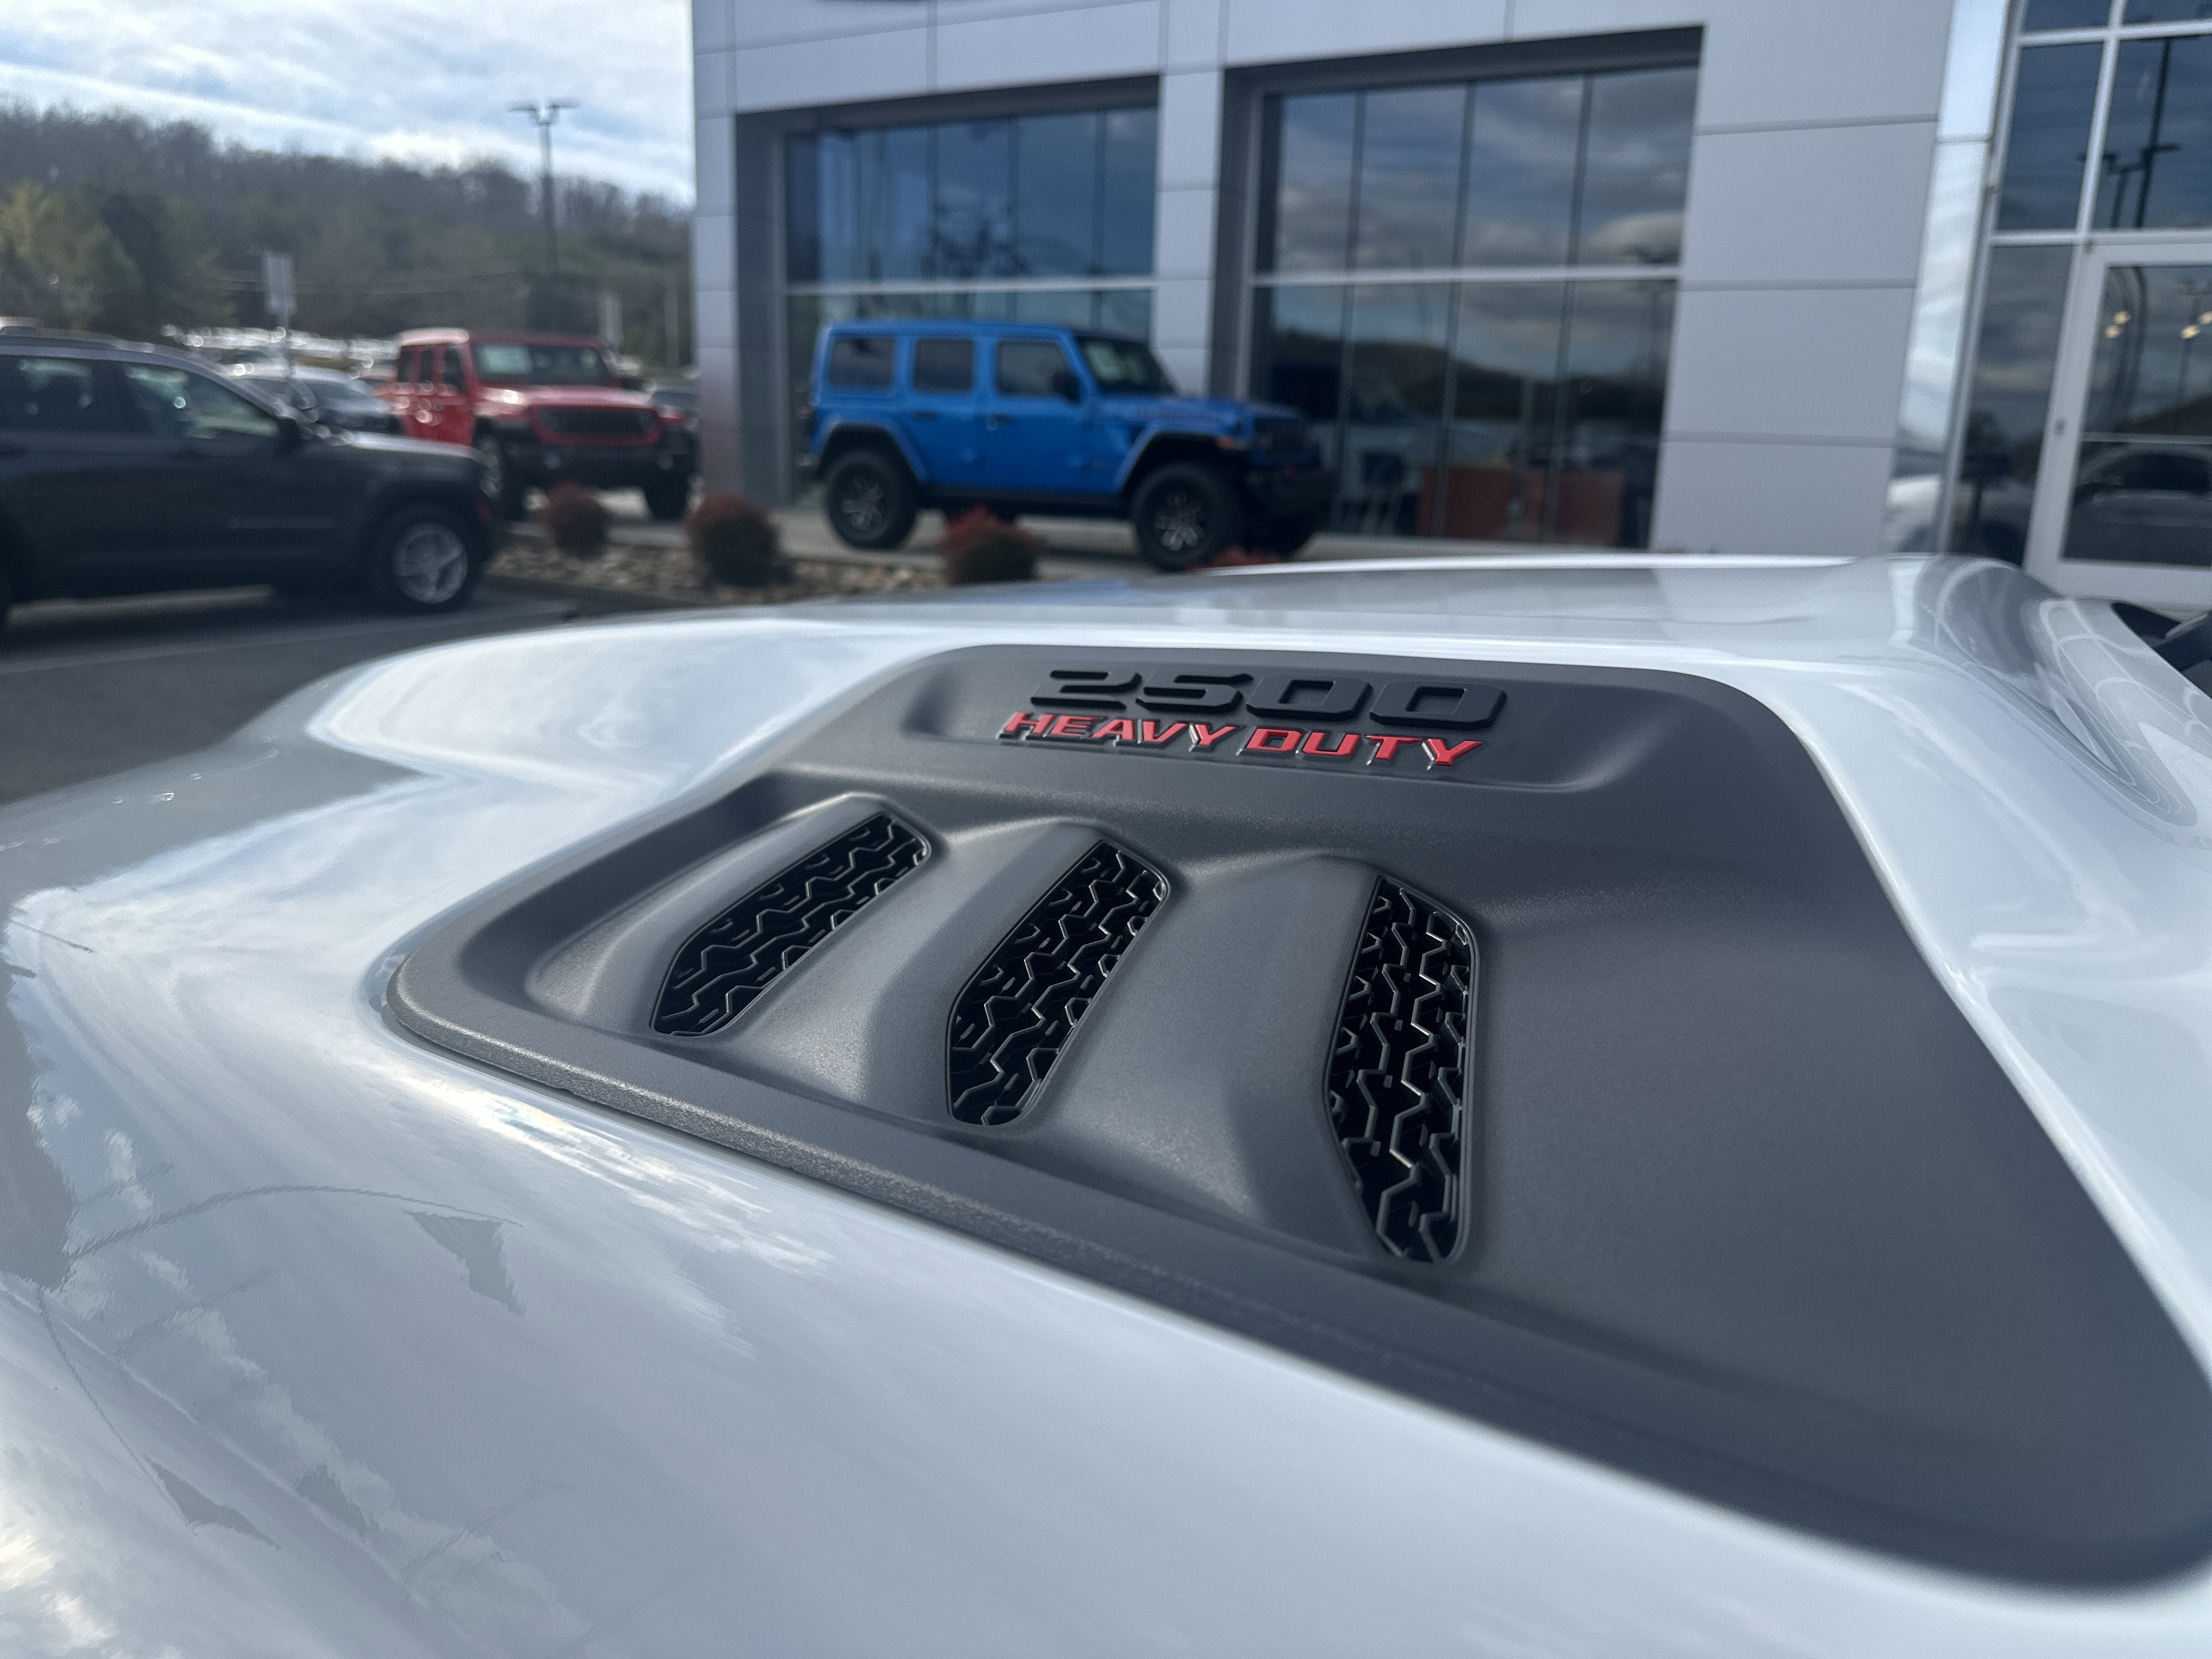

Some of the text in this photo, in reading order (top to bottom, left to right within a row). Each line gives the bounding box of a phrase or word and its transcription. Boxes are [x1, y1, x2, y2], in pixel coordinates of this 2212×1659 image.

[1030, 669, 1507, 729] 2500
[1000, 712, 1483, 767] HEAVY DUTY
